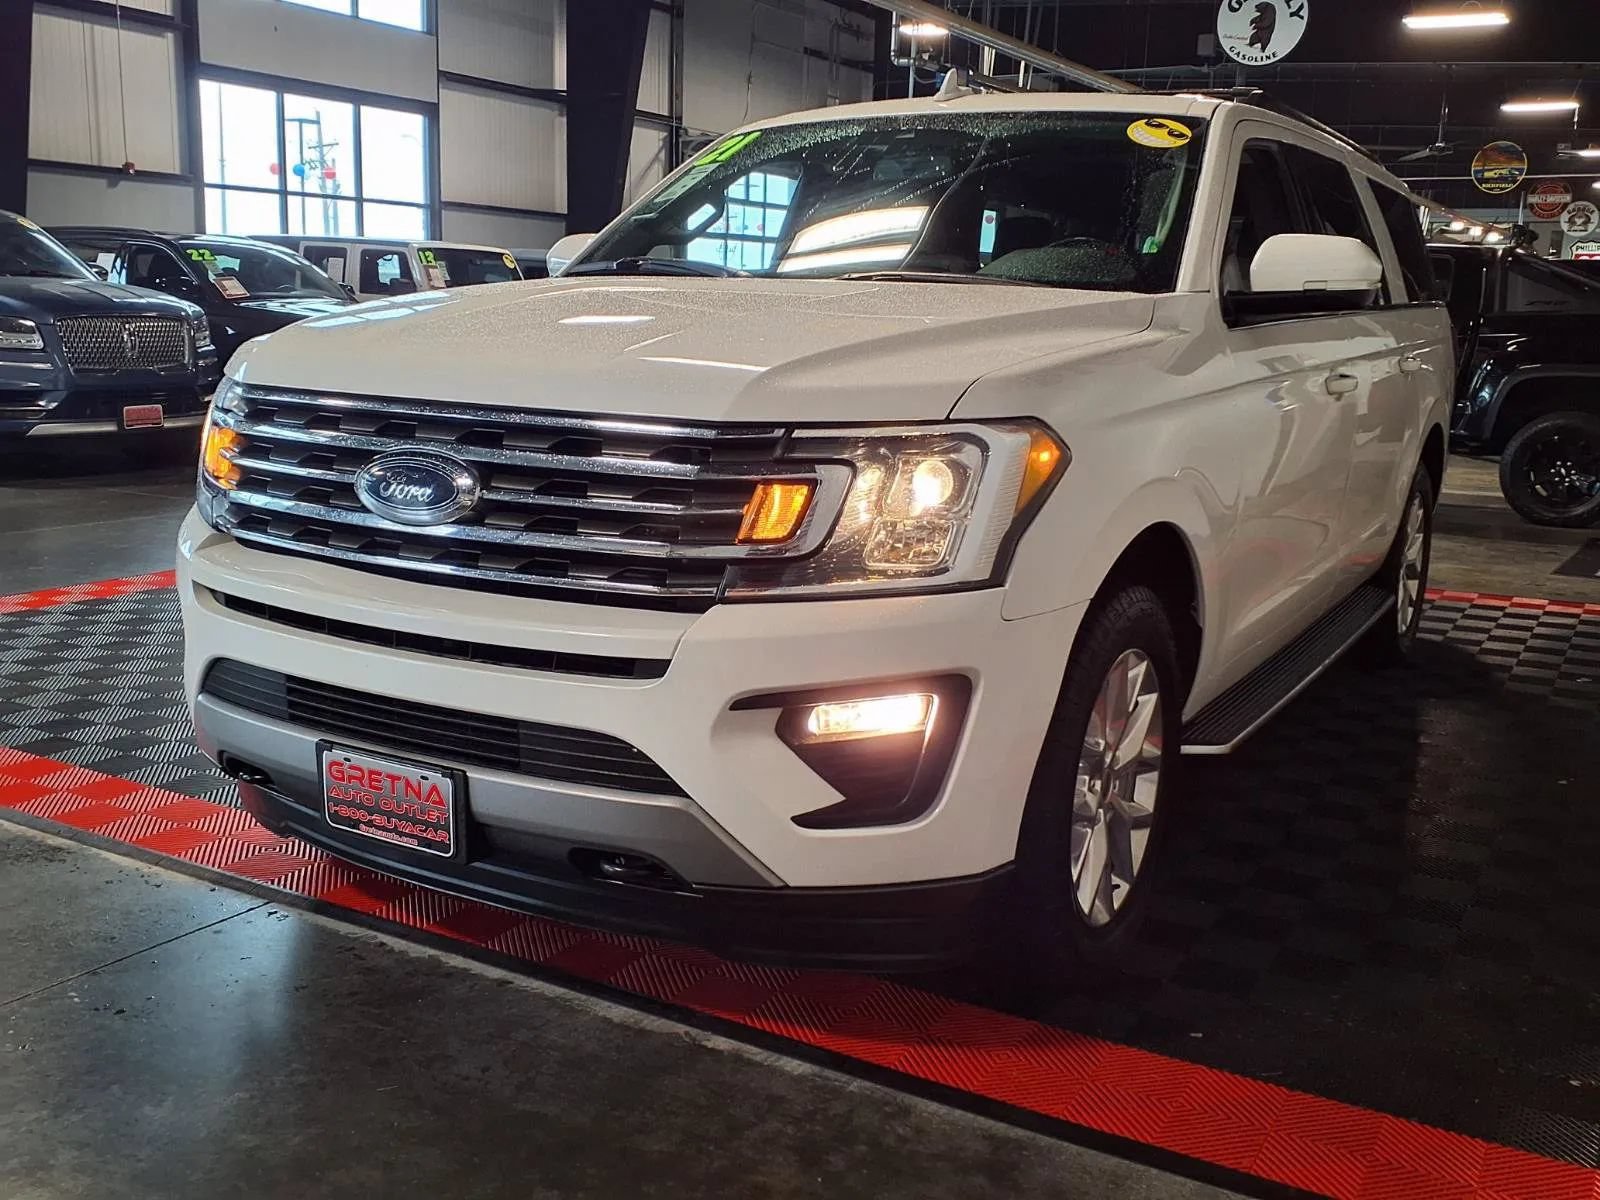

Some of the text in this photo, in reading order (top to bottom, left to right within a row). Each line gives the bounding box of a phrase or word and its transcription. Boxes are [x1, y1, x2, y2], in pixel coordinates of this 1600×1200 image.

[1229, 46, 1279, 62] GASOLINE
[185, 248, 217, 262] 22
[379, 470, 435, 503] Ford
[328, 761, 447, 808] GRETNA
[329, 785, 448, 824] AUTO OUTLET
[328, 802, 449, 844] 1-800-BUYACAR
